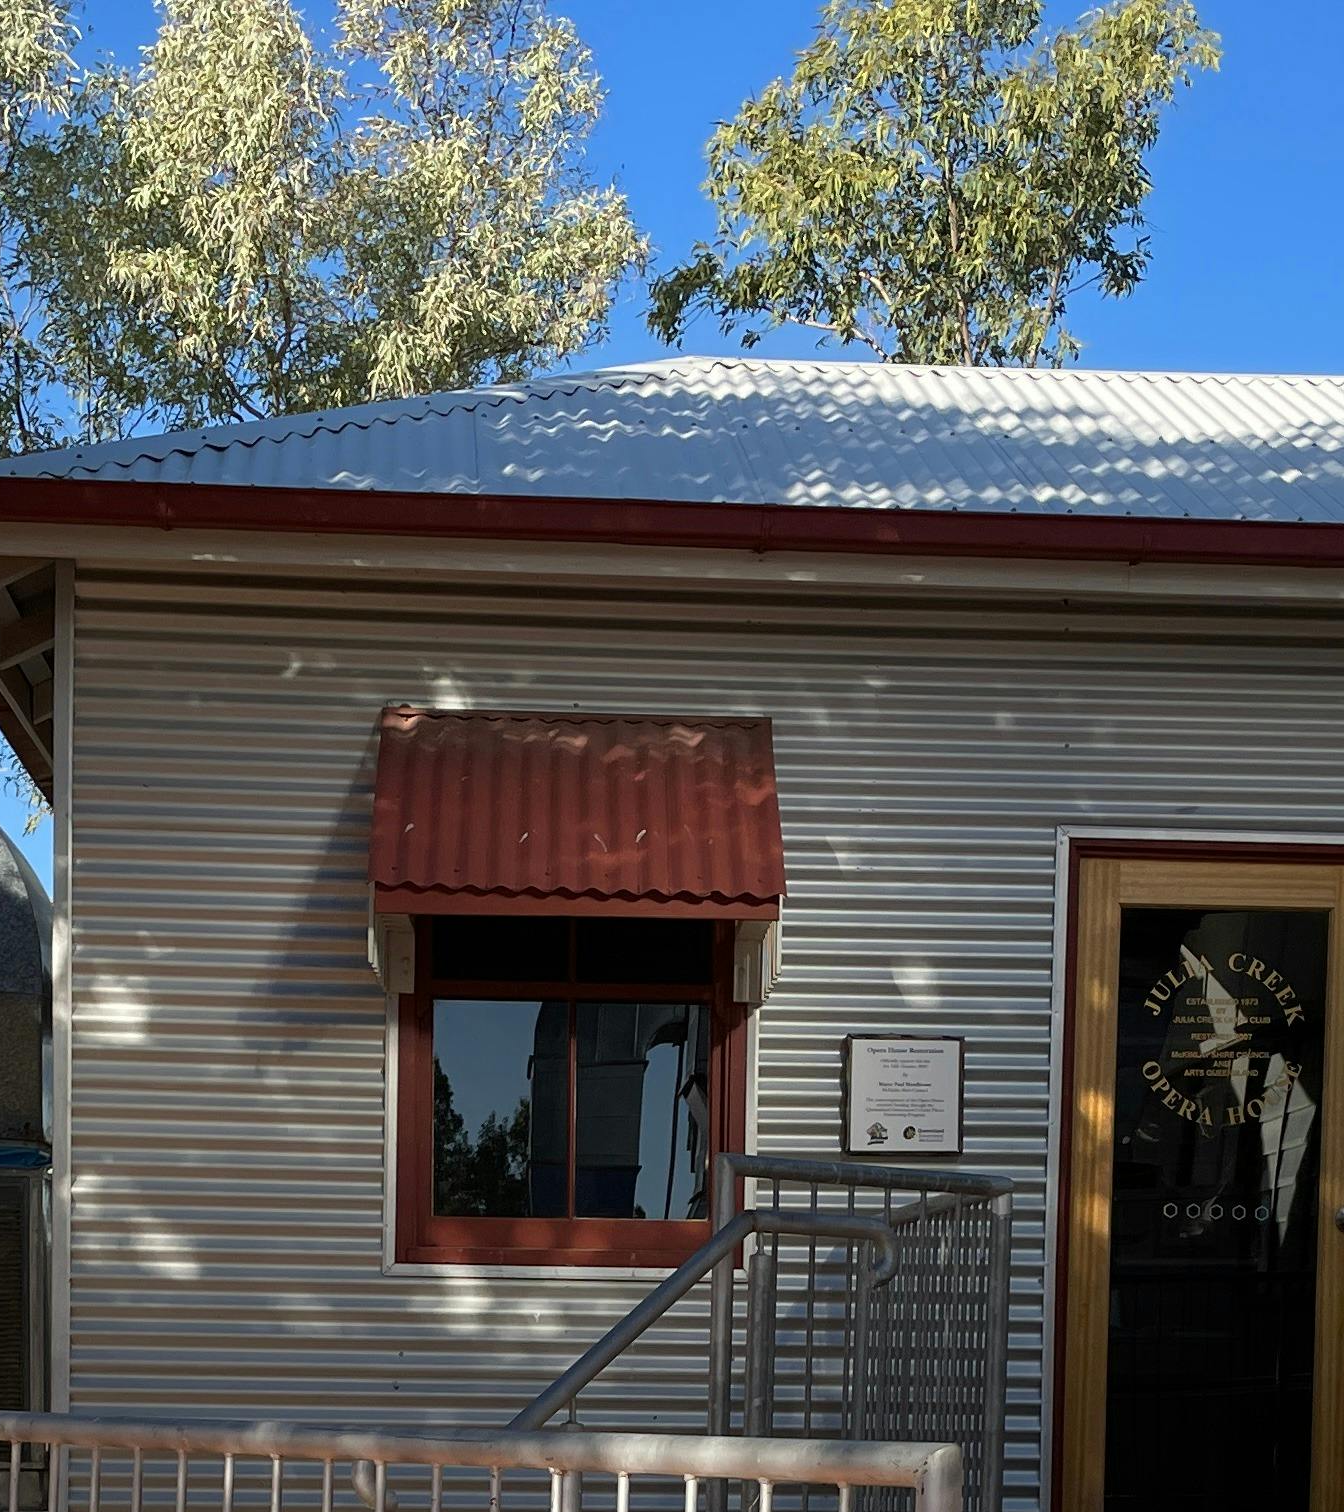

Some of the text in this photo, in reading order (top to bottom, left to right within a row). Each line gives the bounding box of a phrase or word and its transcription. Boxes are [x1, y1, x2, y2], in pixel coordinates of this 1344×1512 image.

[1143, 953, 1305, 1027] JULIA CREEK
[1173, 1016, 1195, 1024] JULIA
[1250, 1016, 1271, 1024] CLUB
[1184, 1069, 1205, 1077] ARTS
[1142, 1061, 1213, 1126] OPERA
